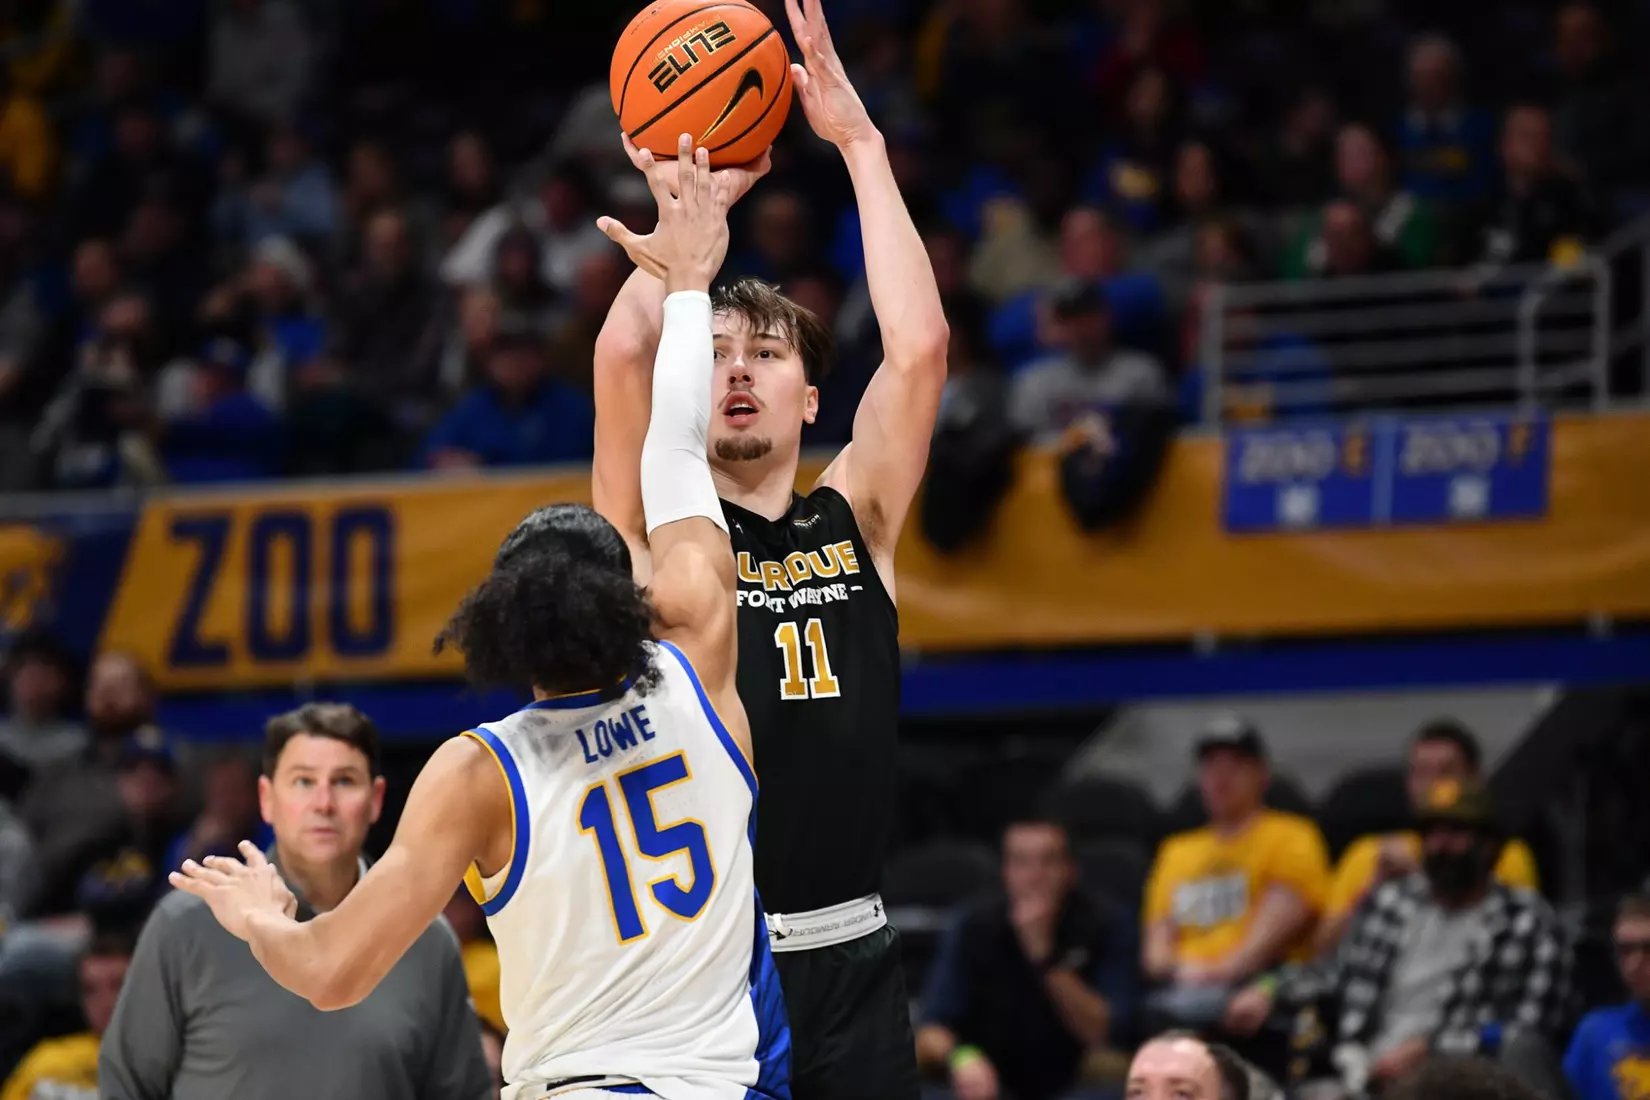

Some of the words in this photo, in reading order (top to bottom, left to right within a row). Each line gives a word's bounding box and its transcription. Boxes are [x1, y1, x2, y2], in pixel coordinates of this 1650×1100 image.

[648, 20, 737, 94] ELITE
[166, 504, 399, 668] ZOO
[737, 540, 860, 591] URDUE
[773, 617, 841, 700] 11
[575, 704, 656, 764] LOWE
[576, 749, 718, 946] 15
